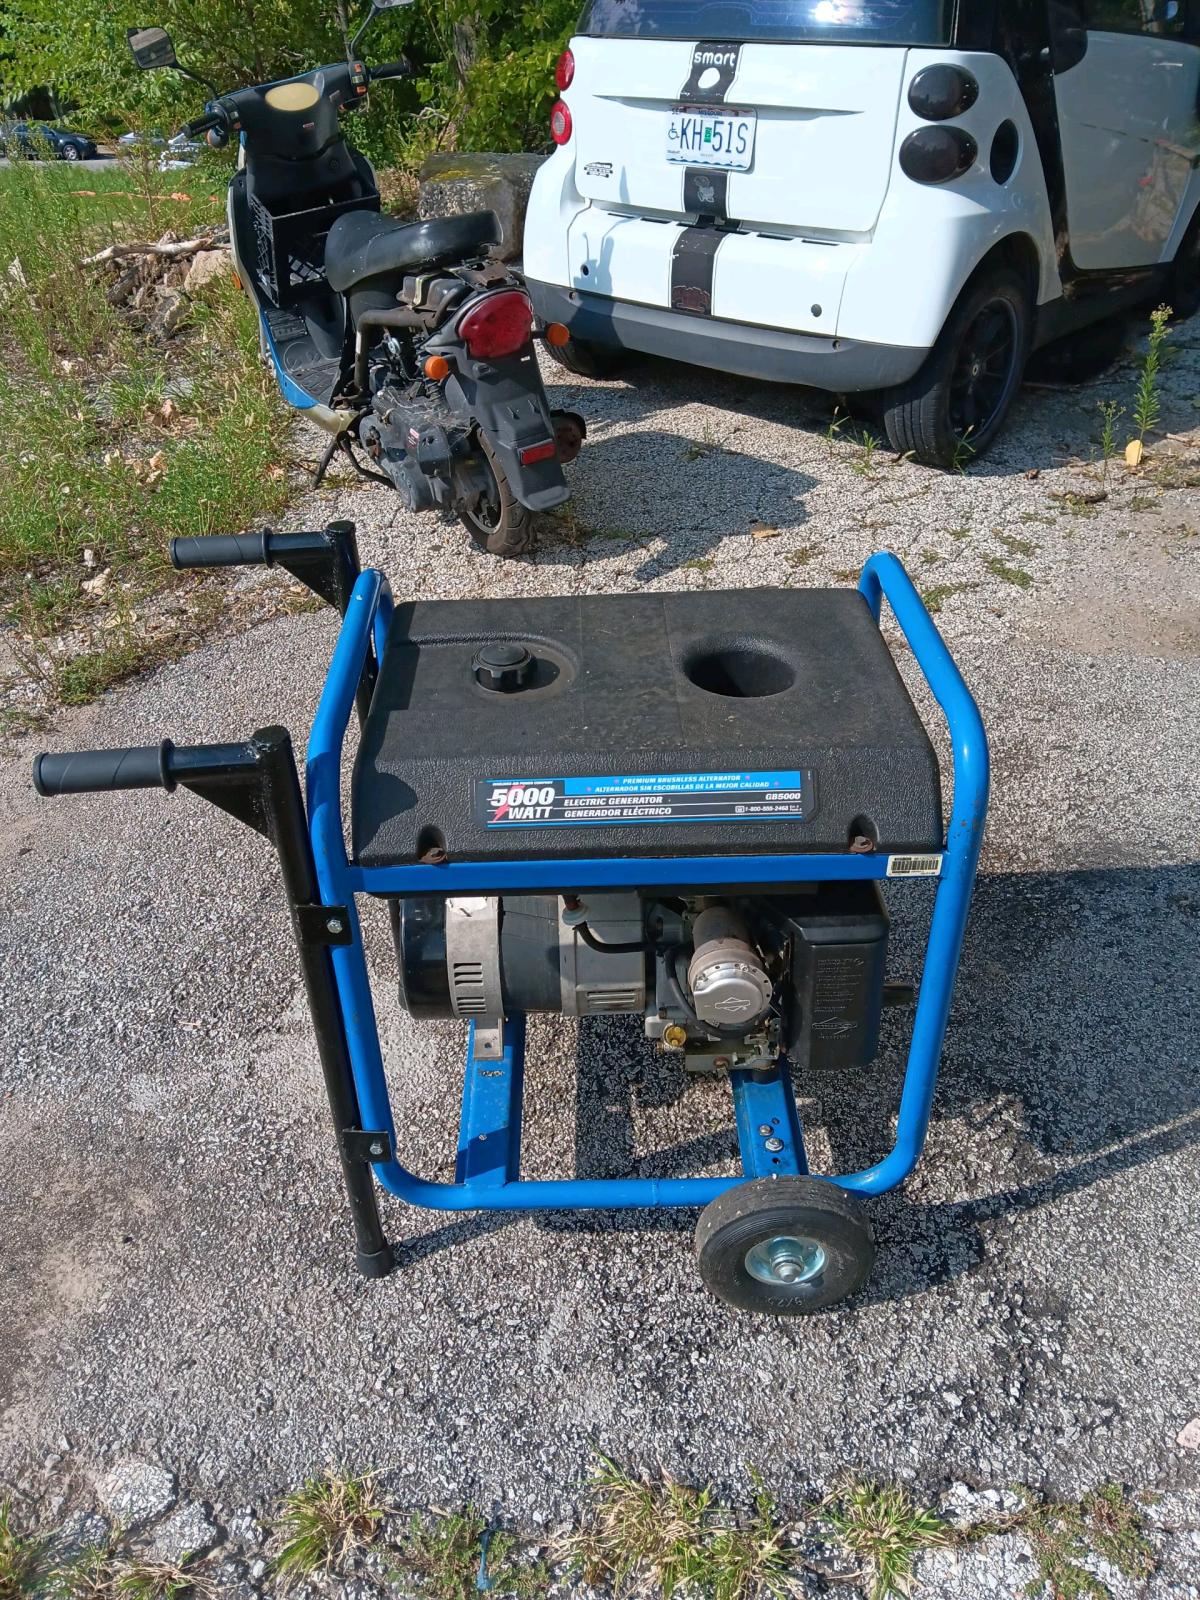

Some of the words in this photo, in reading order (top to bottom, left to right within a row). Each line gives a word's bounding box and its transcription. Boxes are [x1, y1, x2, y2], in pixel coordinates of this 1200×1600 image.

[694, 51, 736, 66] smart
[680, 117, 703, 151] KH
[712, 120, 748, 153] 51S
[623, 777, 656, 785] PREMIUM
[698, 774, 741, 782] ALTERNATOR
[653, 783, 694, 791] ESCOBILLAS
[491, 787, 555, 806] 5000
[563, 798, 606, 807] ELECTRIC
[608, 796, 663, 806] GENERATOR
[765, 792, 801, 801] GB5000
[508, 806, 553, 820] WATT
[564, 809, 621, 818] GENERADOR
[622, 806, 672, 817] ELÉCTRICO
